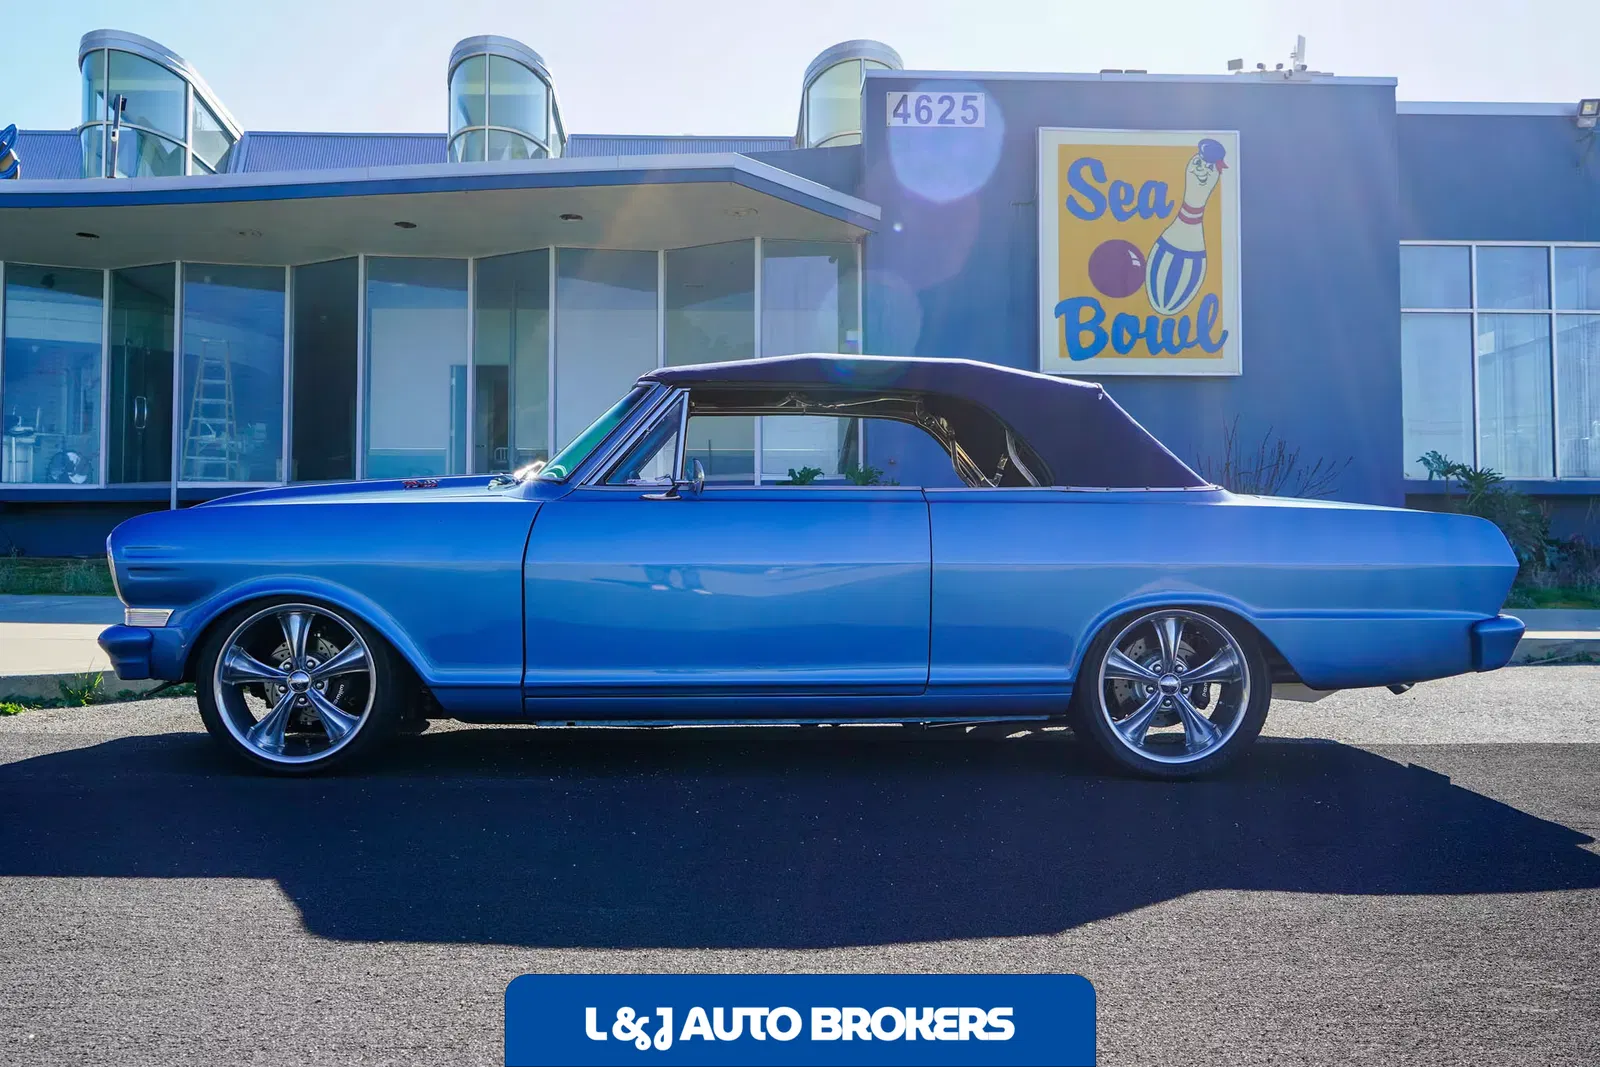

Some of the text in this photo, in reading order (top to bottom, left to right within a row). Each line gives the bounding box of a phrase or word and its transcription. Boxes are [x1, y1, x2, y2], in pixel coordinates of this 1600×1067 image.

[892, 94, 979, 125] 4625
[1065, 156, 1175, 223] Sea
[1054, 292, 1229, 362] Bowl
